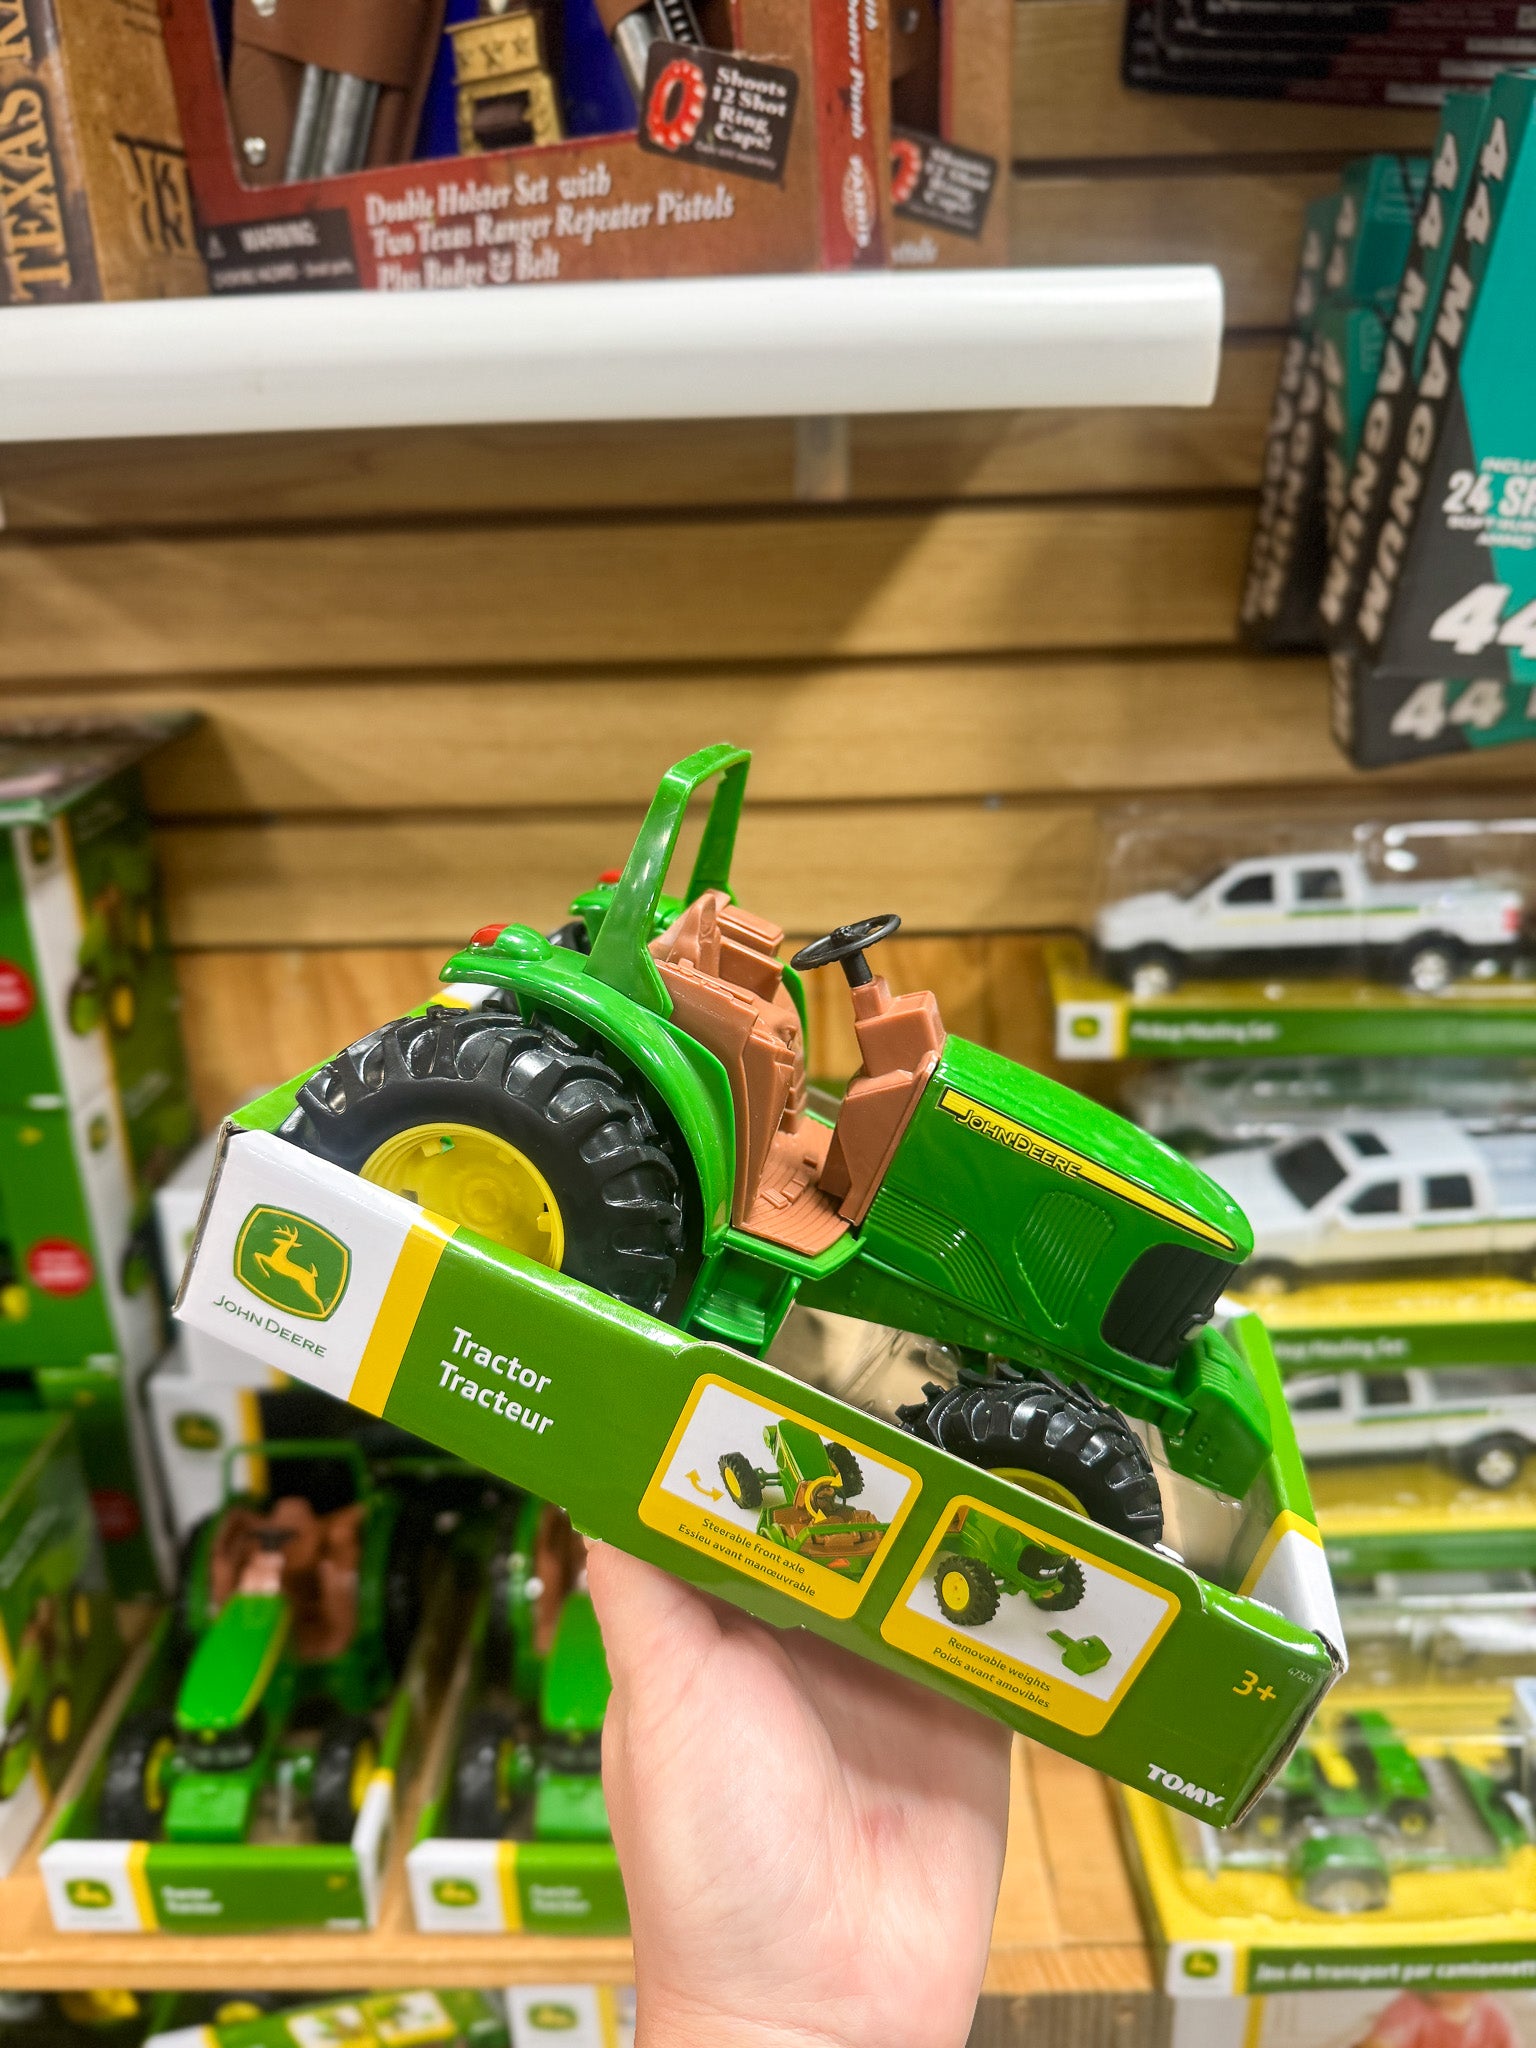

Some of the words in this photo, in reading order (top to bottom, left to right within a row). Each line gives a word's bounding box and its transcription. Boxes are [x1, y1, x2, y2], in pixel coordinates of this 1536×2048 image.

[713, 85, 735, 104] 12
[739, 91, 786, 117] Shot
[717, 66, 786, 98] Shoots
[720, 105, 768, 134] Ring
[0, 88, 72, 301] TEXAS
[366, 193, 434, 225] Double
[438, 180, 511, 216] Holster
[514, 173, 548, 205] Set
[557, 161, 611, 199] with
[1417, 131, 1459, 250] 44
[1464, 116, 1508, 245] 44
[369, 226, 415, 257] Two
[414, 220, 473, 252] Texas
[475, 213, 552, 247] Ranger
[556, 203, 652, 245] Repeater
[657, 183, 734, 225] Pistols
[424, 254, 486, 290] Badge
[489, 248, 512, 283] &
[516, 243, 559, 280] Belt
[1320, 266, 1427, 627] MAGNUM
[1358, 262, 1473, 646] MAGNUM
[1442, 470, 1493, 516] 24
[1390, 678, 1505, 741] 44
[957, 1110, 1012, 1147] JOHN
[1014, 1134, 1082, 1178] DEERE
[213, 1295, 263, 1327] JOHN
[265, 1318, 327, 1358] DEERE
[452, 1326, 552, 1393] Tractor
[439, 1360, 554, 1435] Tracteur
[678, 1523, 711, 1545] Essieu
[713, 1543, 743, 1560] avant
[744, 1556, 816, 1597] manœuvrable
[702, 1518, 752, 1548] Steerable
[753, 1544, 782, 1563] front
[783, 1559, 805, 1574] axle
[933, 1647, 962, 1667] Poids
[964, 1662, 995, 1682] avant
[996, 1678, 1050, 1708] amovibles
[948, 1637, 1007, 1671] Removable
[1008, 1667, 1051, 1692] weights
[1232, 1669, 1277, 1701] 3+
[1147, 1763, 1225, 1808] TOMY
